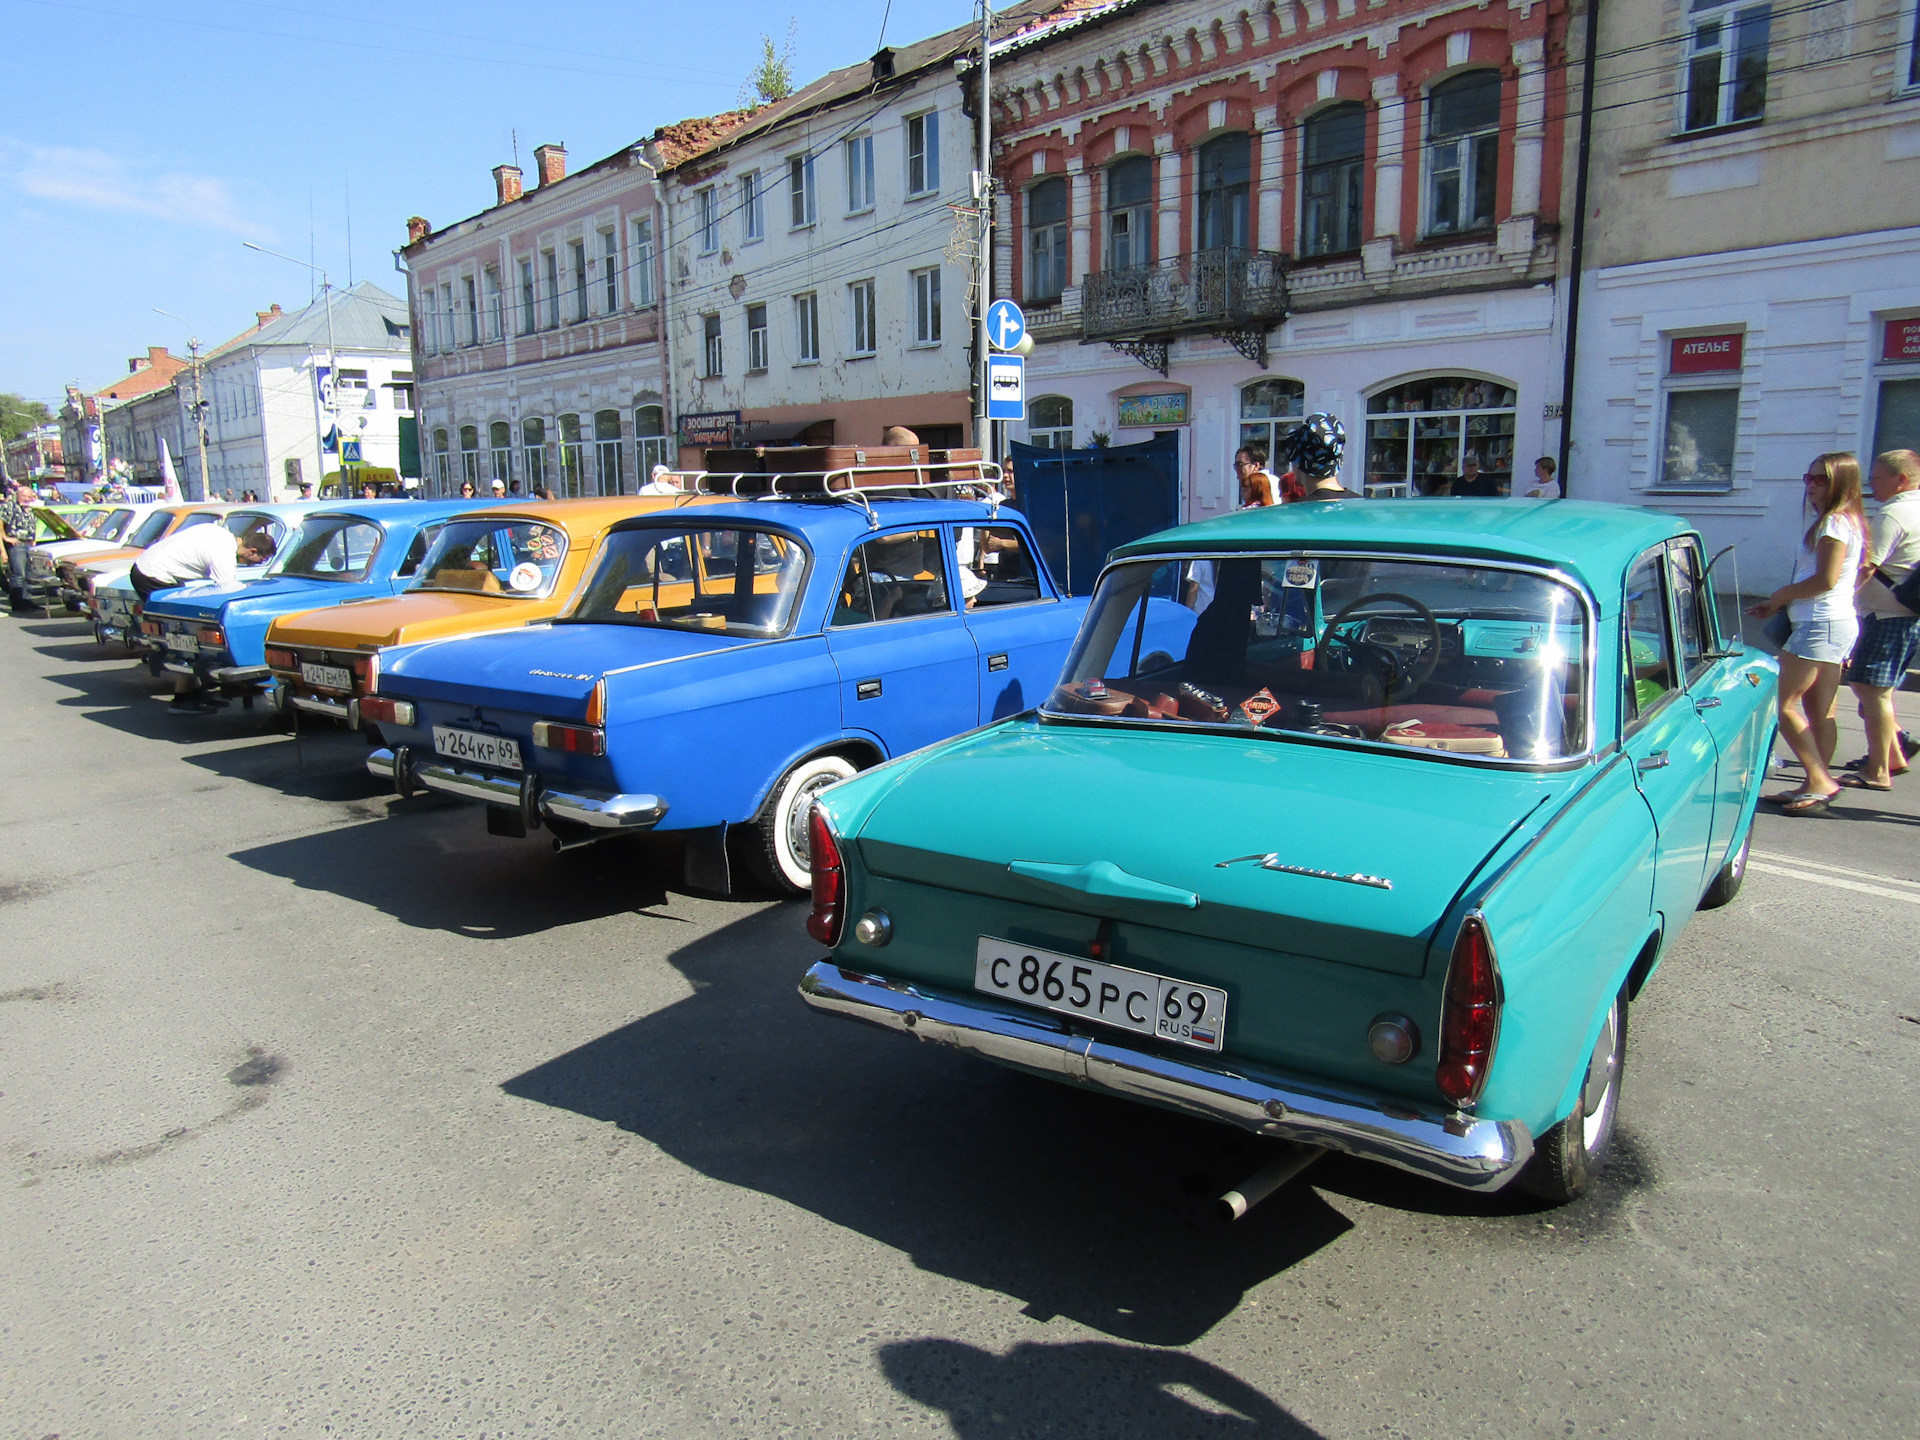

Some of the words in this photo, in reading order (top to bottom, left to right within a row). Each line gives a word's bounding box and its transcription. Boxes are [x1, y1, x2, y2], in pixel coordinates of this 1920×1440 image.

[1903, 326, 1920, 334] ПО
[1682, 341, 1730, 355] АТЕЛЬЕ
[1902, 346, 1920, 354] ОД
[439, 732, 495, 761] У264КР
[499, 741, 513, 760] 69
[991, 955, 1149, 1023] С865РС
[1164, 986, 1208, 1025] 69
[1159, 1019, 1190, 1037] RUS
